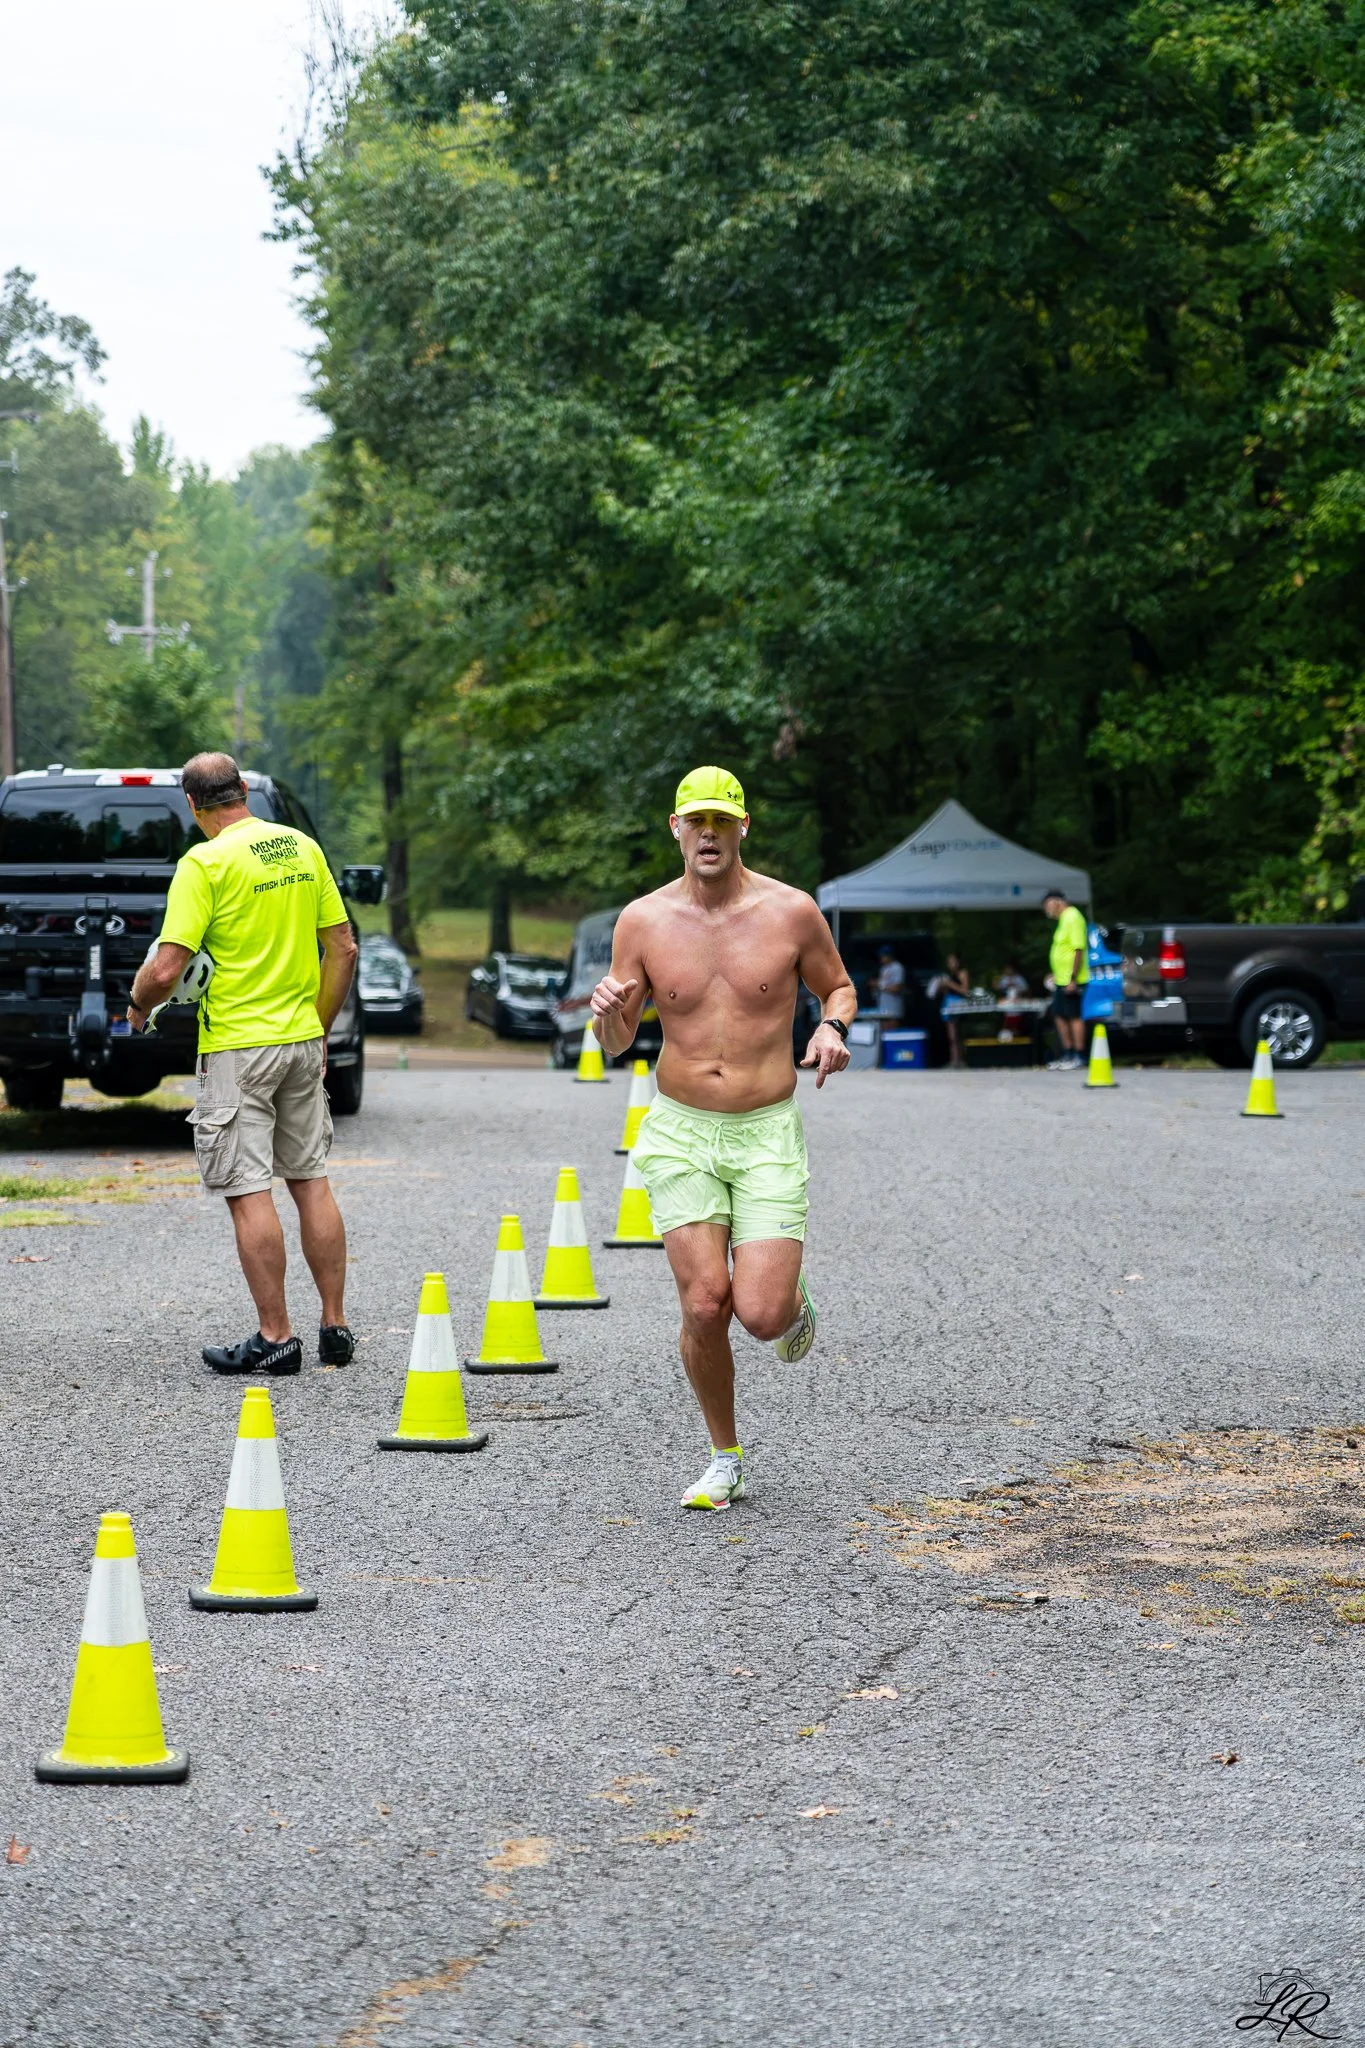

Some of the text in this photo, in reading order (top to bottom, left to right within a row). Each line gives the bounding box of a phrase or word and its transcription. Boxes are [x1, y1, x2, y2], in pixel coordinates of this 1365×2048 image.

[249, 835, 298, 855] MEMPHIS
[259, 847, 298, 863] RUNNERS
[253, 880, 278, 894] FINISH
